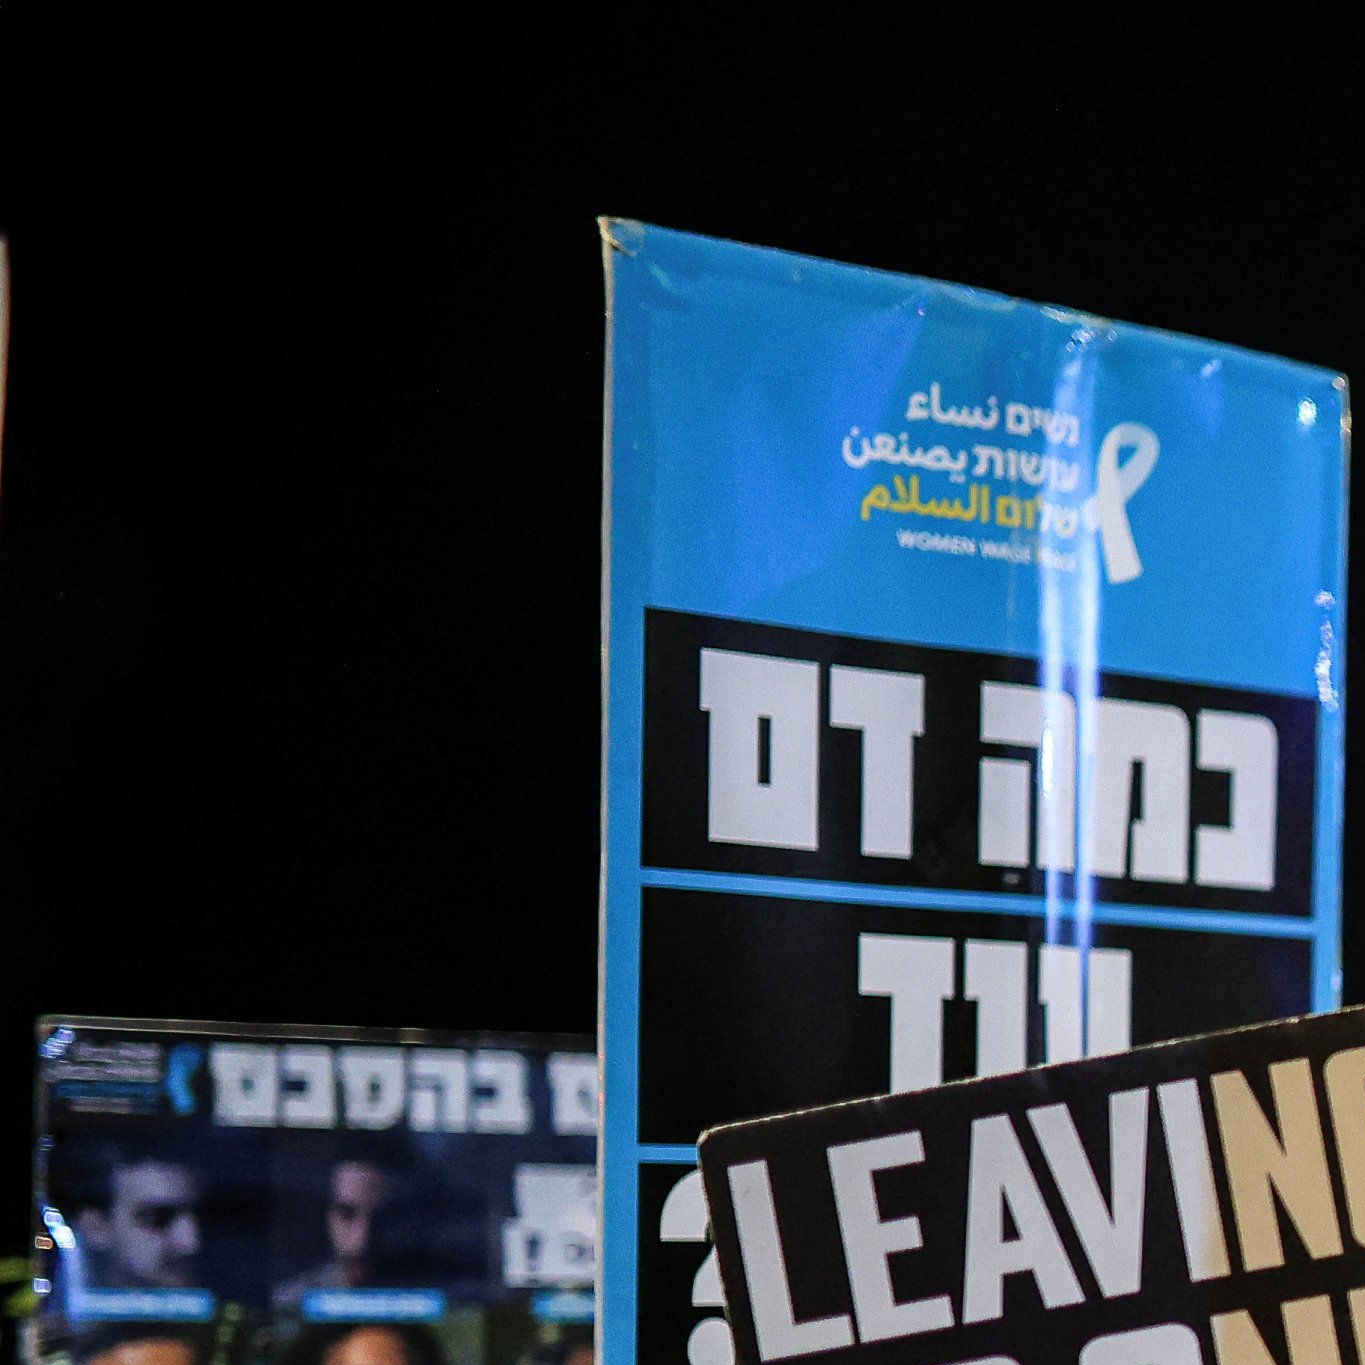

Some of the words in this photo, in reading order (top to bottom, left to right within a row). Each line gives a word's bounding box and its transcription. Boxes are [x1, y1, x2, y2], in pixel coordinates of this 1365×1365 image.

[904, 381, 999, 431] نساء
[860, 474, 990, 524] السلام
[699, 646, 926, 860] דם
[979, 679, 1279, 893] כמה
[209, 1042, 531, 1135] בהסכם
